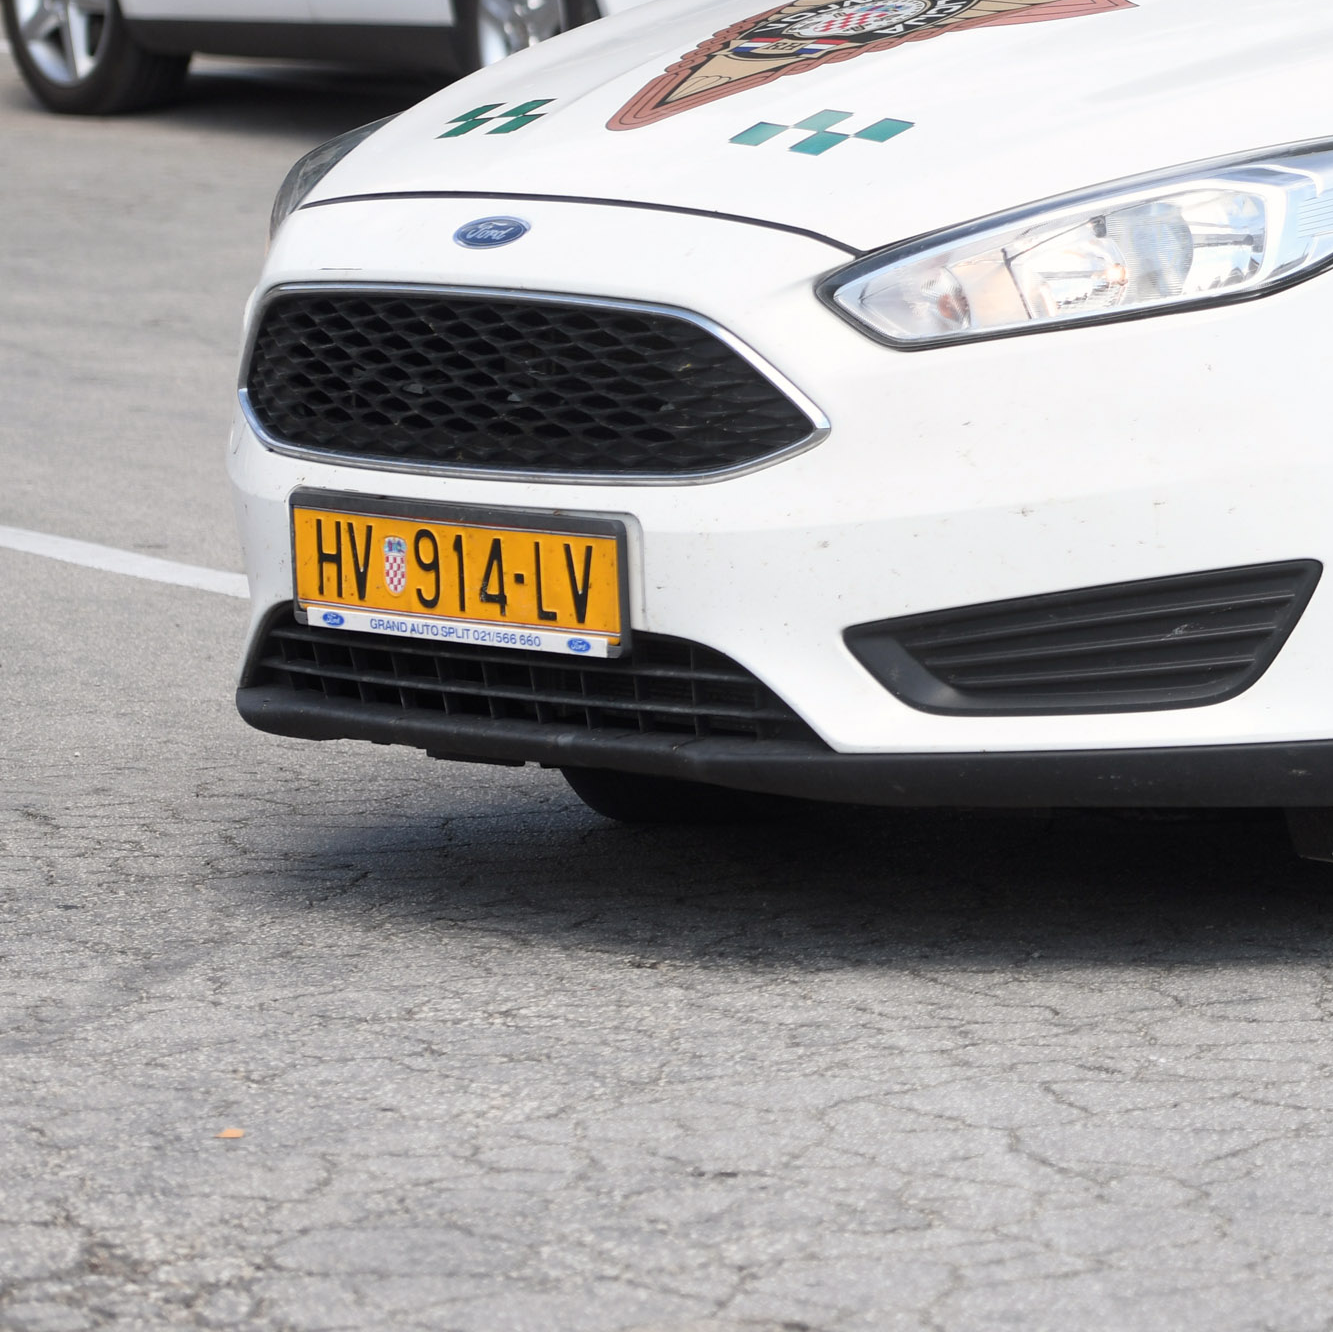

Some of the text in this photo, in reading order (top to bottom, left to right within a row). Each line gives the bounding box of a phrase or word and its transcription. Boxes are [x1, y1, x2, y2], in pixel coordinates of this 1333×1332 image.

[465, 221, 515, 241] Ford
[316, 518, 593, 624] HV 914-LV
[369, 618, 542, 647] GRAND AUTO SPLIT 021/566 660
